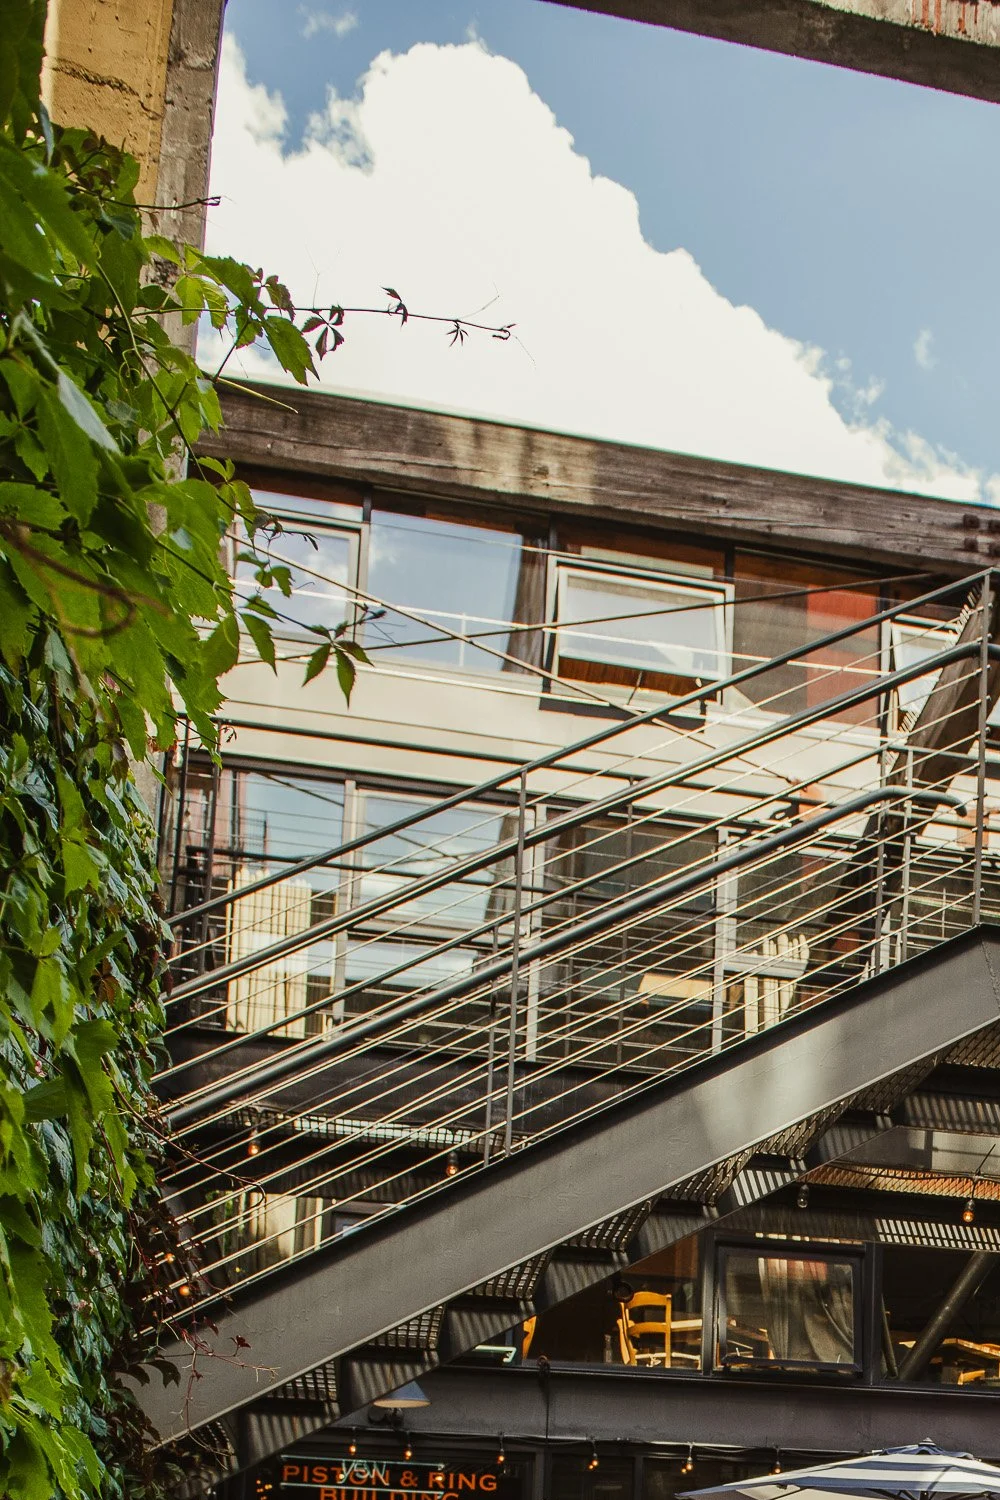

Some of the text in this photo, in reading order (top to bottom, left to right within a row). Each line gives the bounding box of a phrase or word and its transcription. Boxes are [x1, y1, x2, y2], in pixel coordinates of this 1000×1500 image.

[282, 1465, 390, 1486] PISTON
[400, 1470, 418, 1487] &
[428, 1472, 498, 1491] RING
